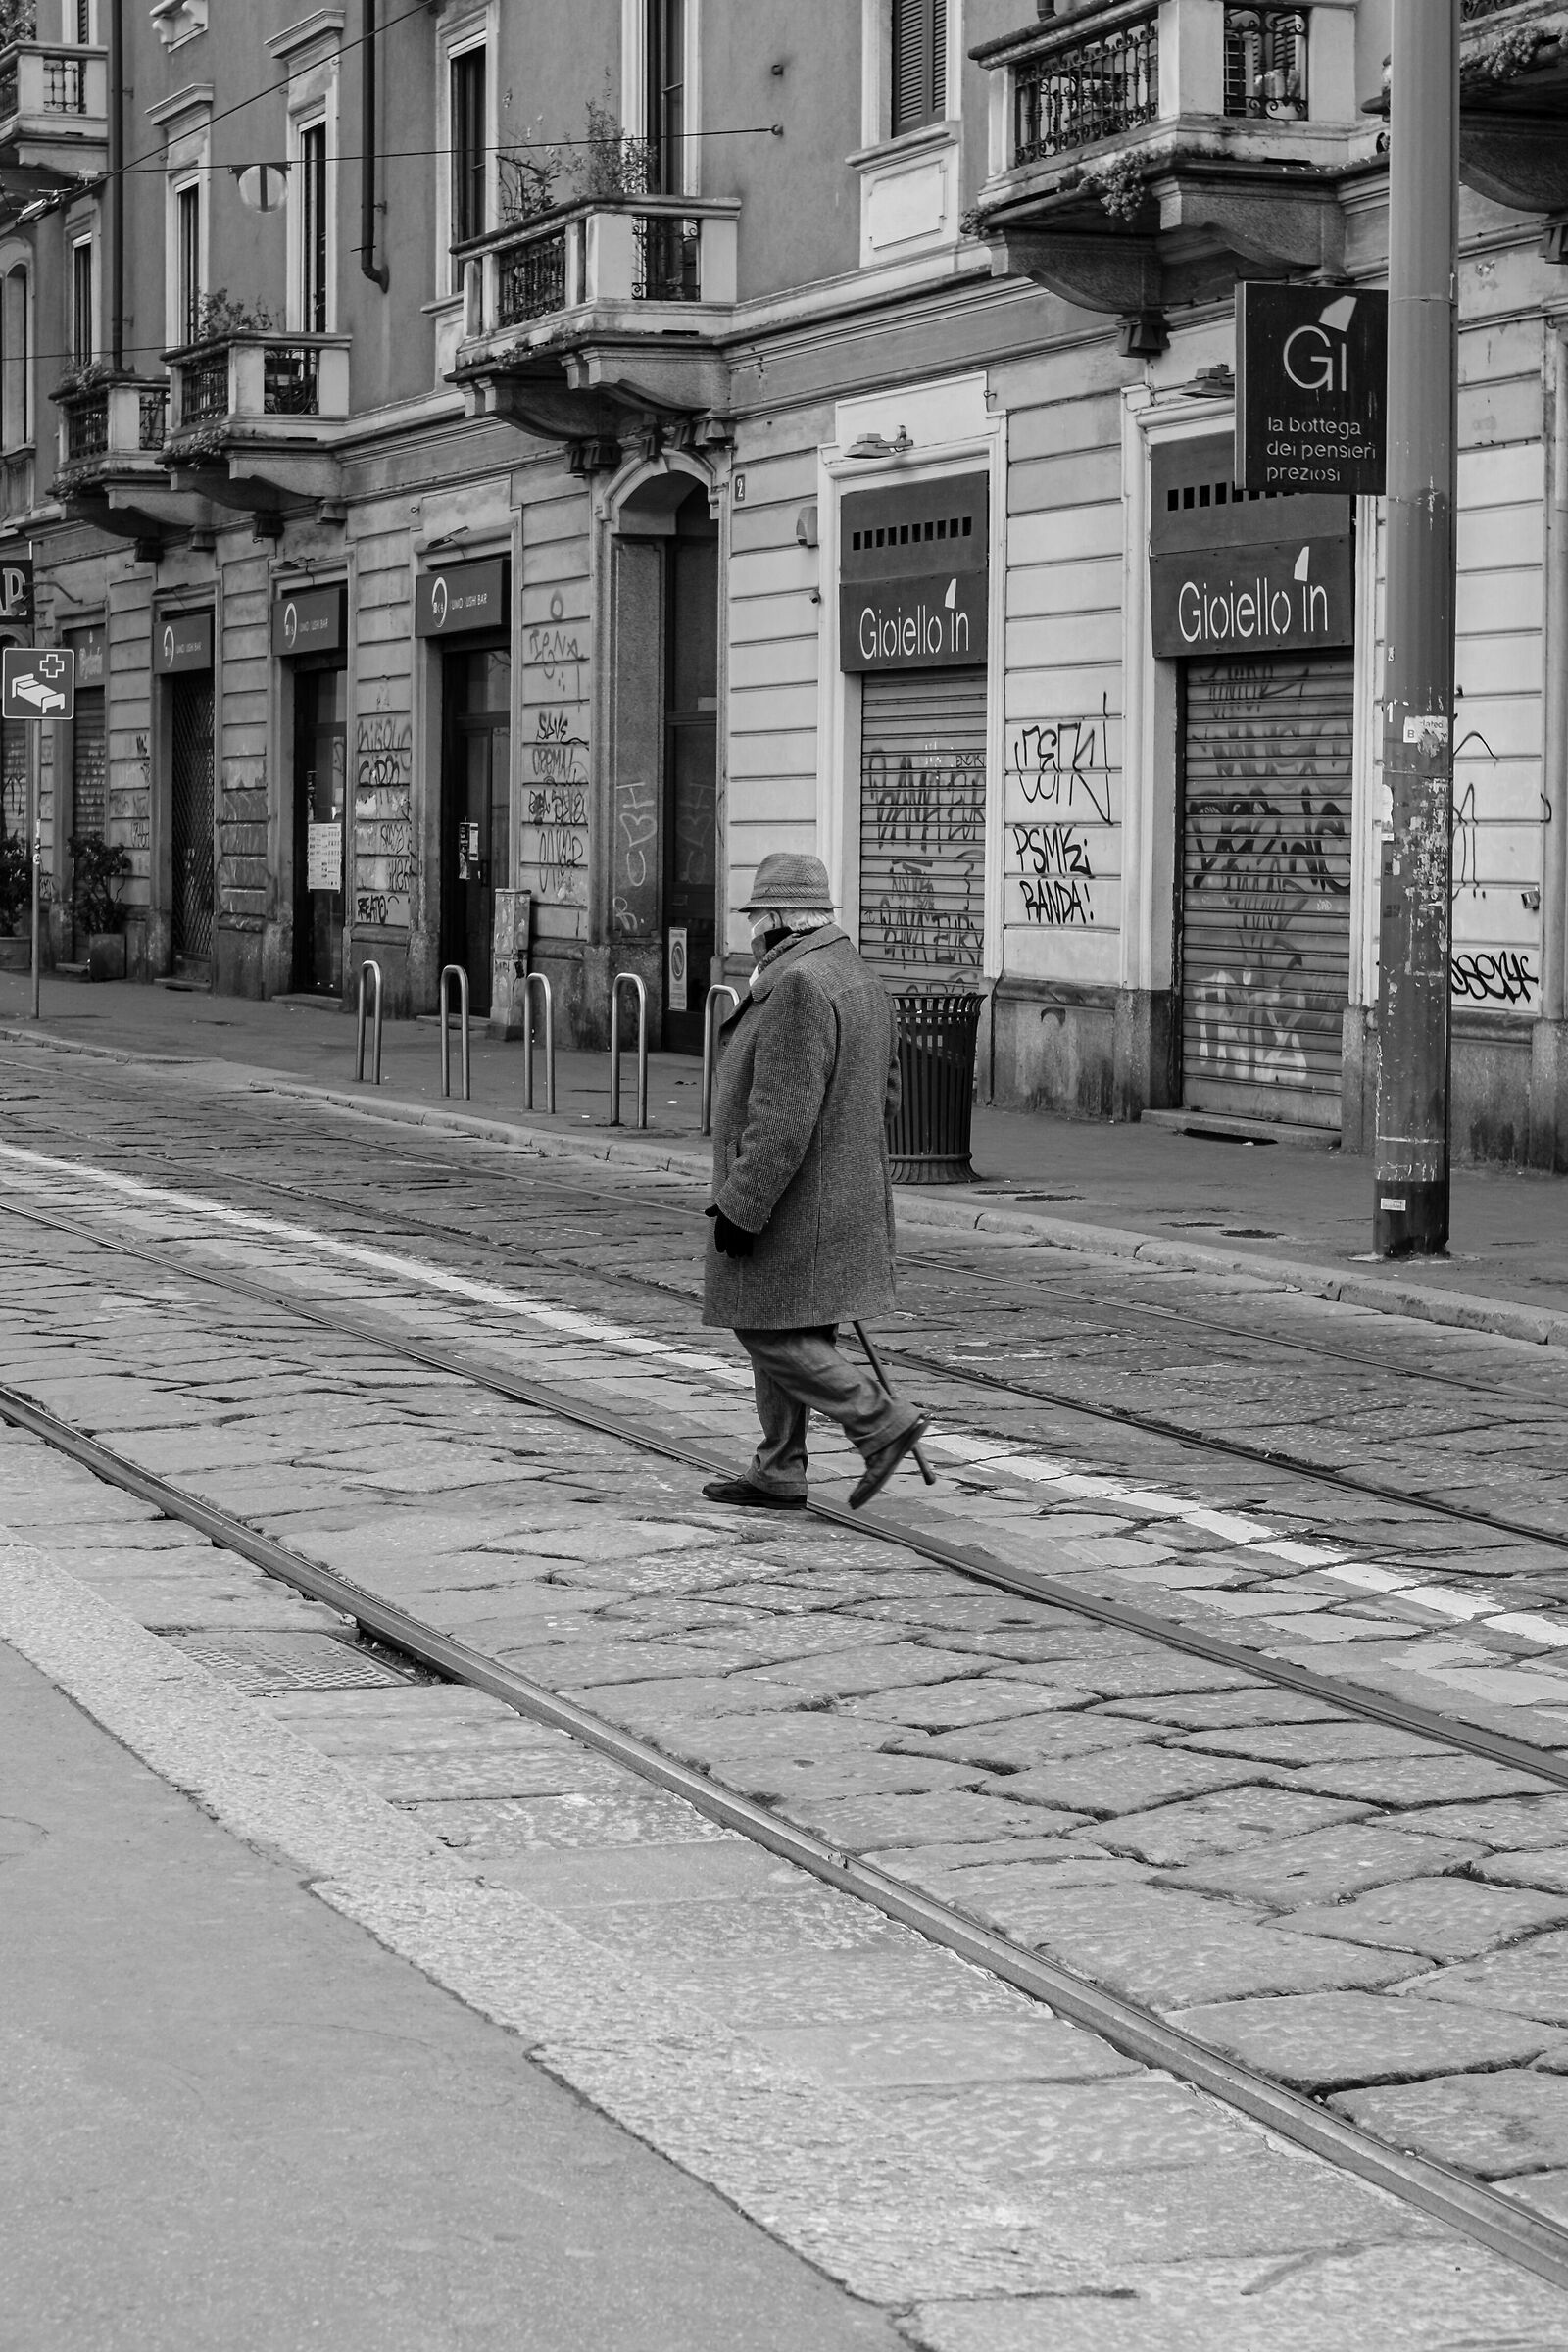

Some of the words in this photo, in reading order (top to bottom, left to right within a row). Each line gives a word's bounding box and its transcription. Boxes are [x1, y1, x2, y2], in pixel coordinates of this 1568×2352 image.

[1268, 416, 1284, 433] la
[1289, 416, 1362, 440] bottega
[1266, 440, 1297, 457] dei
[1301, 441, 1376, 460] pensieri
[1266, 466, 1341, 482] preziosi
[737, 478, 744, 498] 2
[1178, 576, 1291, 643] Gioiello
[859, 604, 943, 660] Gioiello
